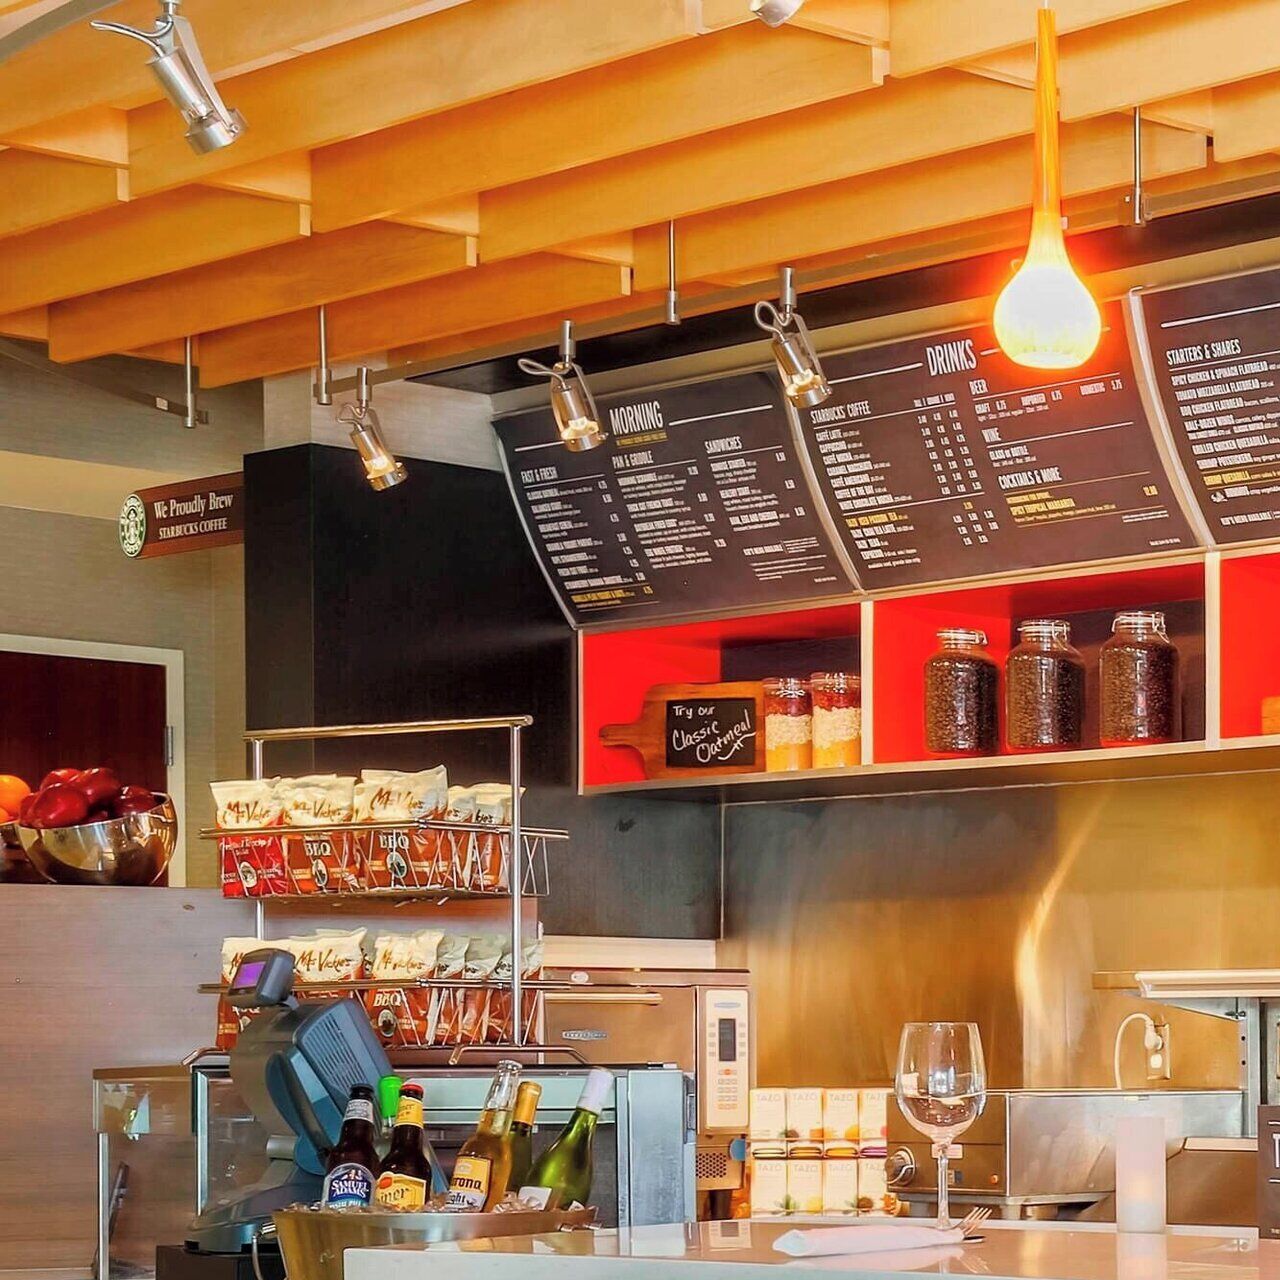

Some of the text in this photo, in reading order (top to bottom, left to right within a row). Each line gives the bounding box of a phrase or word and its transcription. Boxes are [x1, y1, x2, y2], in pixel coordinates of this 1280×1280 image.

[926, 338, 977, 377] DRINKS
[1166, 338, 1242, 366] STARTERS & SHARES
[969, 378, 988, 395] BEER
[846, 400, 872, 417] COFFEE
[609, 400, 664, 436] MORNING
[981, 426, 1002, 443] WINE
[704, 435, 743, 454] SANDWICHES
[612, 455, 624, 469] PAN
[520, 469, 536, 484] FAST
[998, 466, 1063, 489] COCKTAILS & MORE
[154, 491, 234, 519] We Proudly Brew
[159, 517, 228, 540] STARBUCKS COFFEE
[672, 704, 716, 719] Try our
[672, 720, 720, 752] Classic
[696, 708, 752, 764] Oatmeal
[305, 841, 332, 857] BBQ
[373, 993, 401, 1007] BBQ
[332, 1179, 368, 1191] SAMUEL
[332, 1187, 368, 1199] ADAMS
